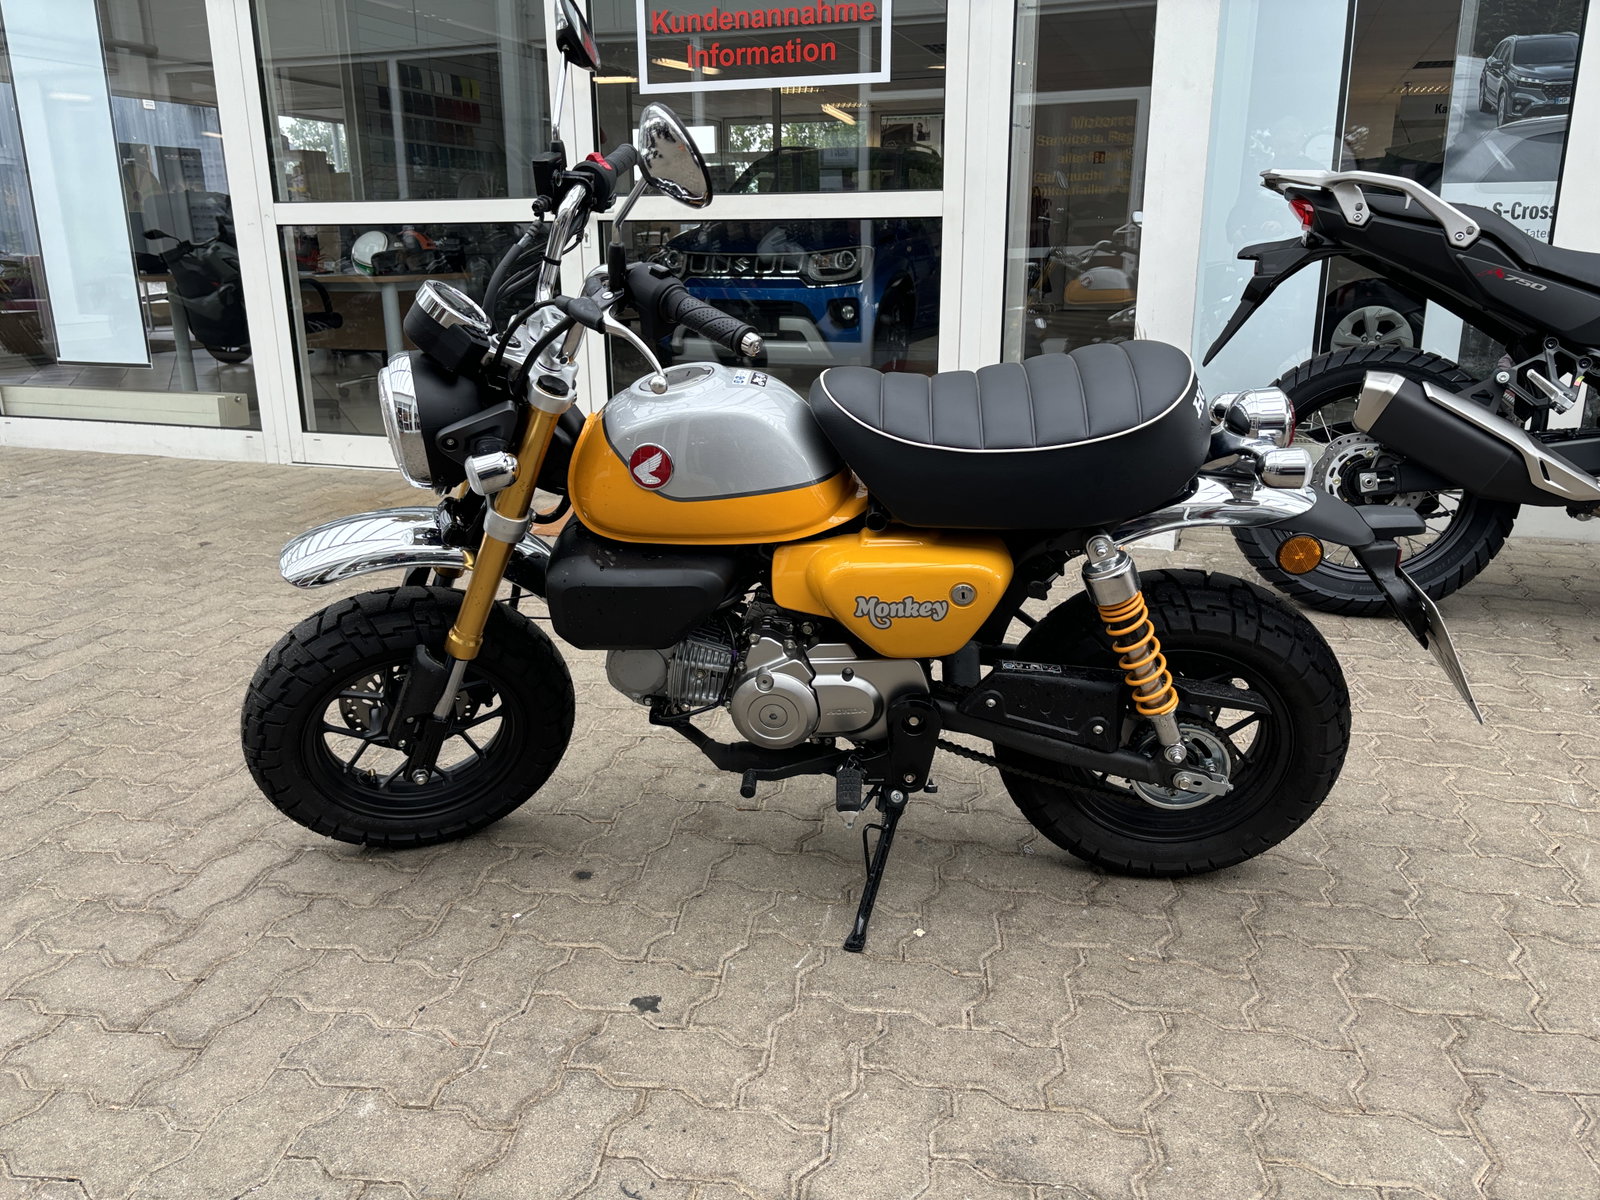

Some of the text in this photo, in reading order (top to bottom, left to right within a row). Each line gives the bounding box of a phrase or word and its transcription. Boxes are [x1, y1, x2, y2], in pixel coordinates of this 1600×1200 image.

[652, 0, 876, 34] Kundenannahme
[687, 38, 836, 67] Information
[1492, 201, 1554, 220] S-Cross
[854, 596, 949, 629] Monkey
